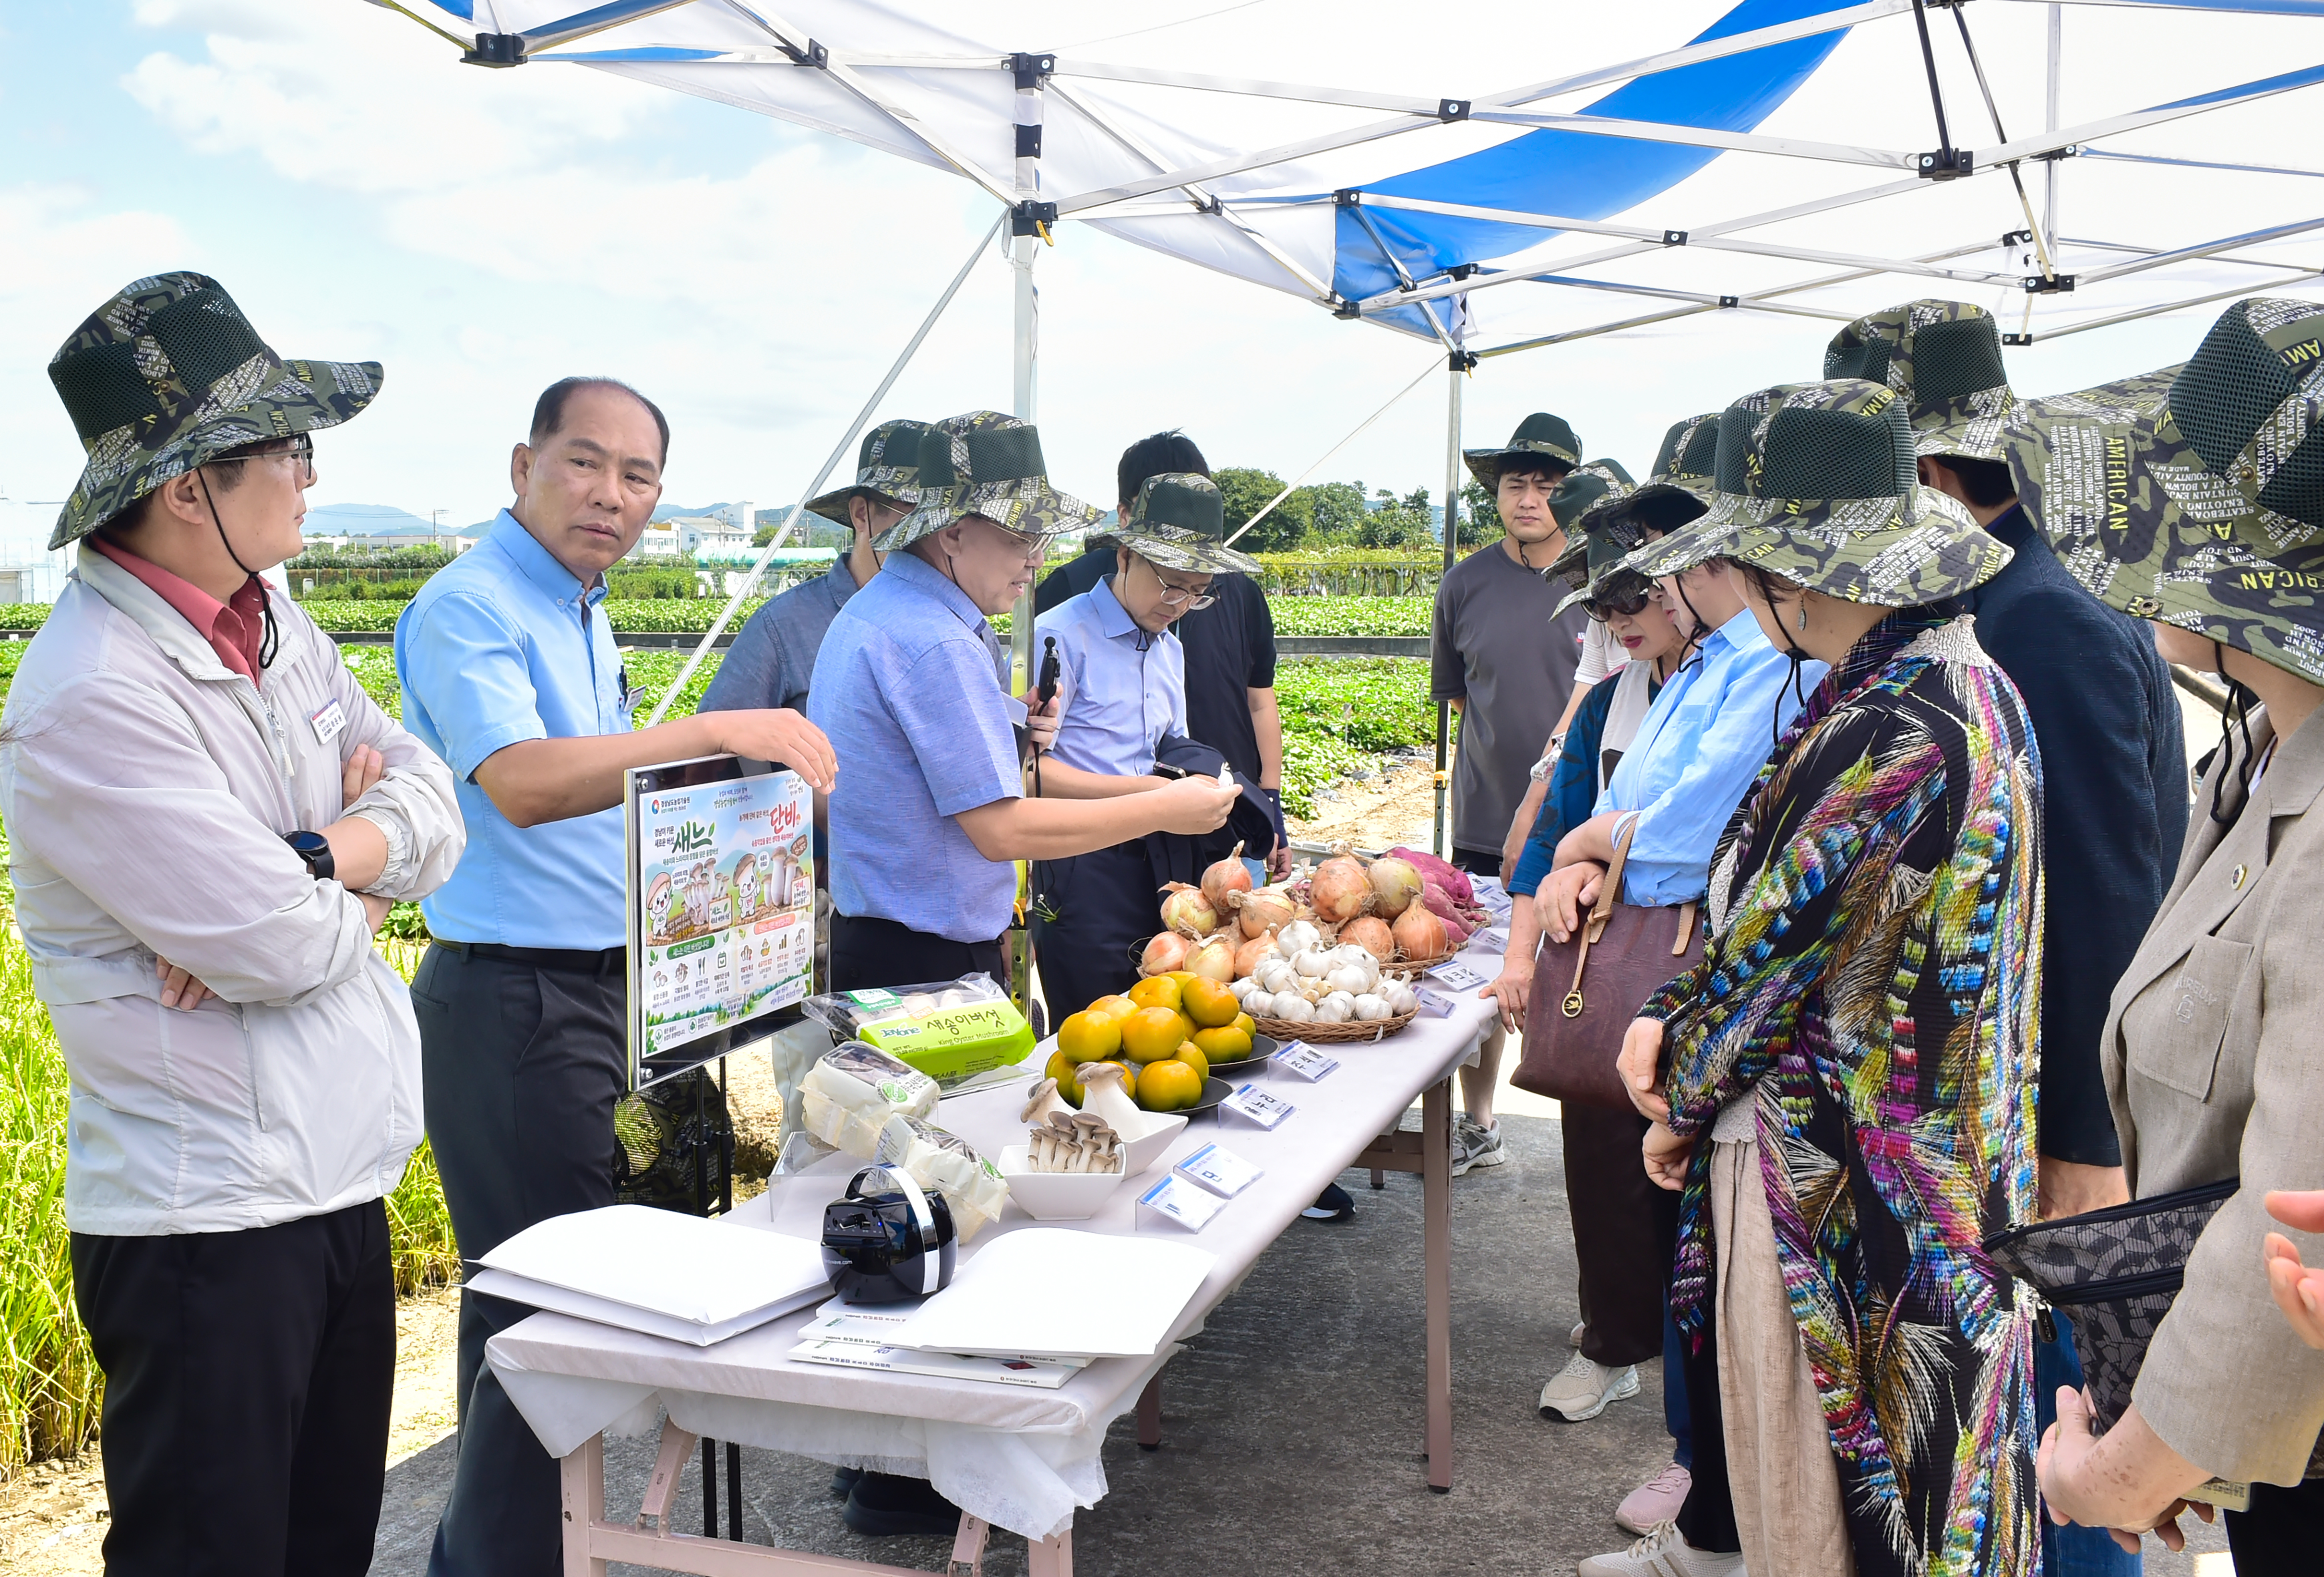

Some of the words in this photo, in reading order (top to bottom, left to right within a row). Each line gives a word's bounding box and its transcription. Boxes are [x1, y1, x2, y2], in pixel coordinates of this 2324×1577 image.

[2105, 437, 2128, 530] AMERICAN
[2054, 514, 2062, 533] 2002
[770, 800, 796, 834] 단비
[654, 827, 666, 837] 경남이
[667, 826, 674, 835] 키운
[672, 820, 713, 854] 새느
[655, 838, 666, 848] 새로운
[927, 1009, 1005, 1035] 새송이버섯
[938, 1038, 954, 1046] King
[954, 1035, 975, 1044] Oyster
[976, 1030, 1010, 1040] Mushroom
